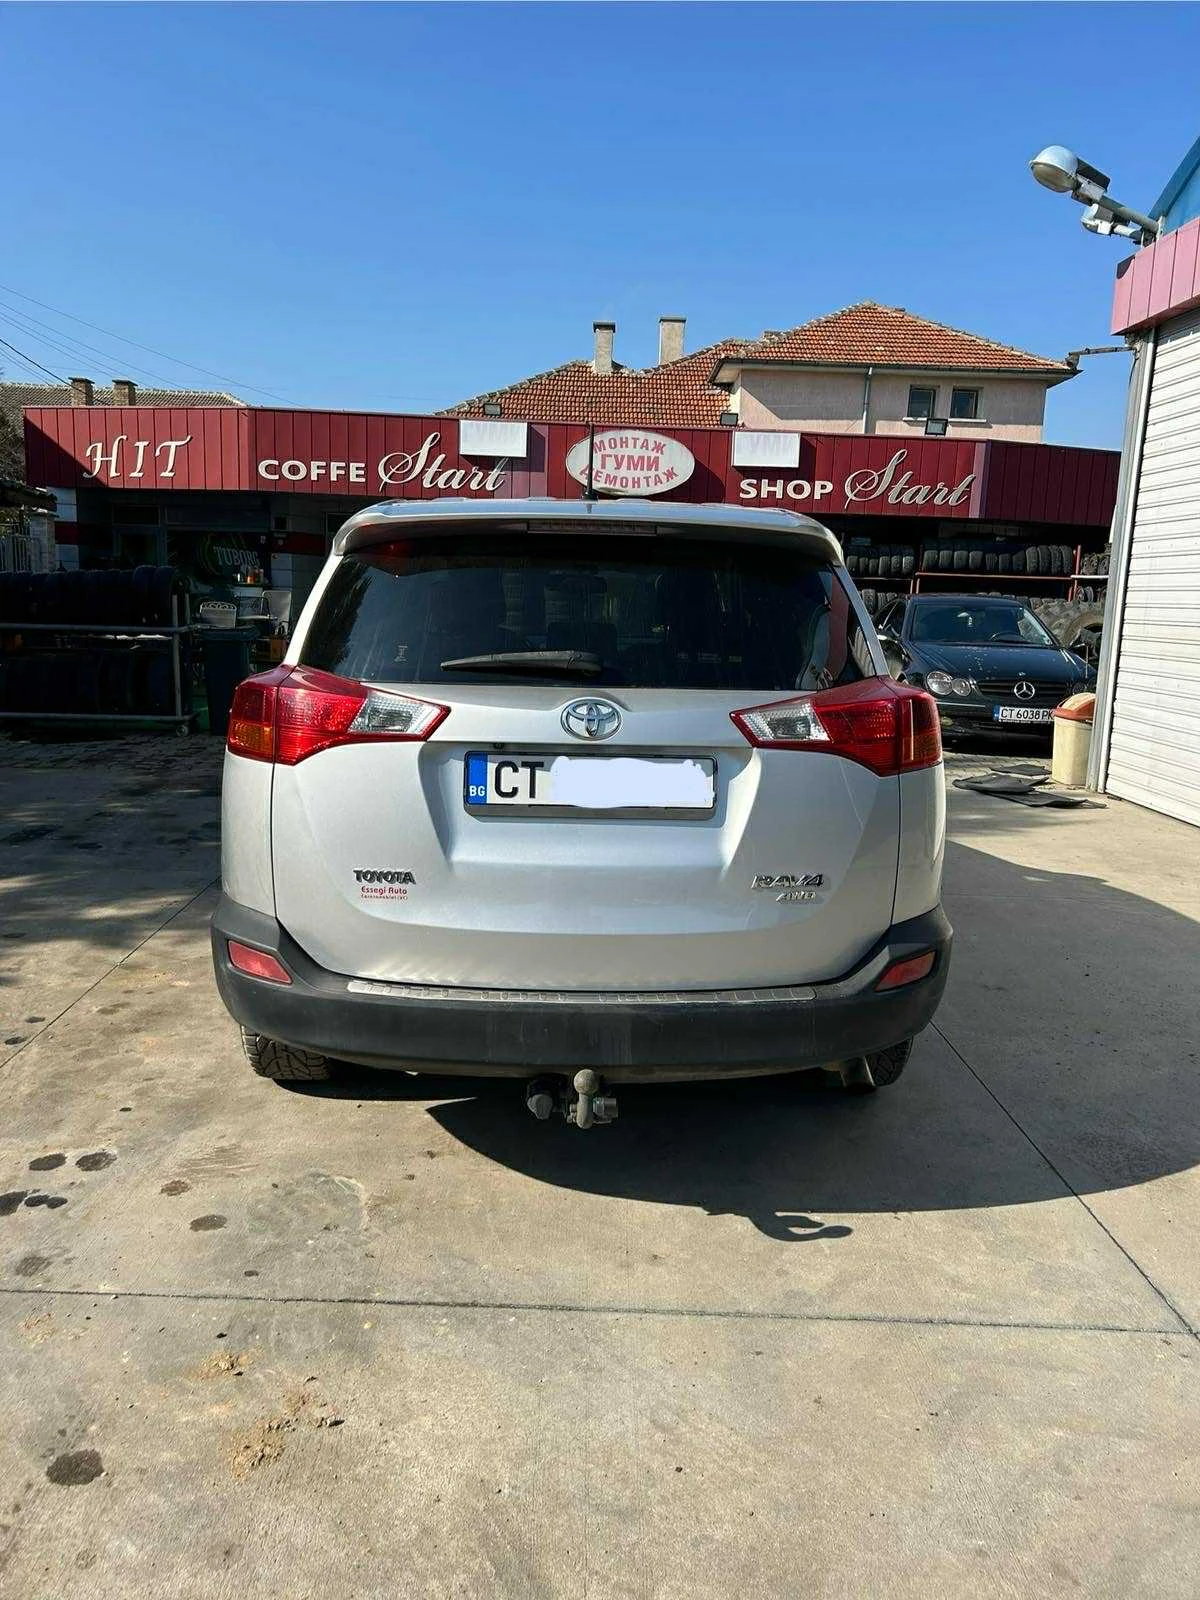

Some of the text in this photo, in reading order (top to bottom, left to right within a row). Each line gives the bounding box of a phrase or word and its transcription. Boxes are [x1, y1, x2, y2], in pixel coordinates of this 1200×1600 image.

[593, 436, 667, 456] МОНТАЖ
[83, 435, 192, 478] HIT
[258, 431, 507, 493] COFFE Start
[600, 453, 660, 471] ГУМИ
[739, 449, 976, 509] SHOP Start
[1001, 708, 1015, 719] CT
[494, 760, 545, 799] CT
[469, 785, 486, 797] BG
[353, 869, 417, 885] TOYOTA
[751, 873, 824, 889] RAV4
[388, 887, 408, 895] Auto
[775, 891, 817, 903] AWD
